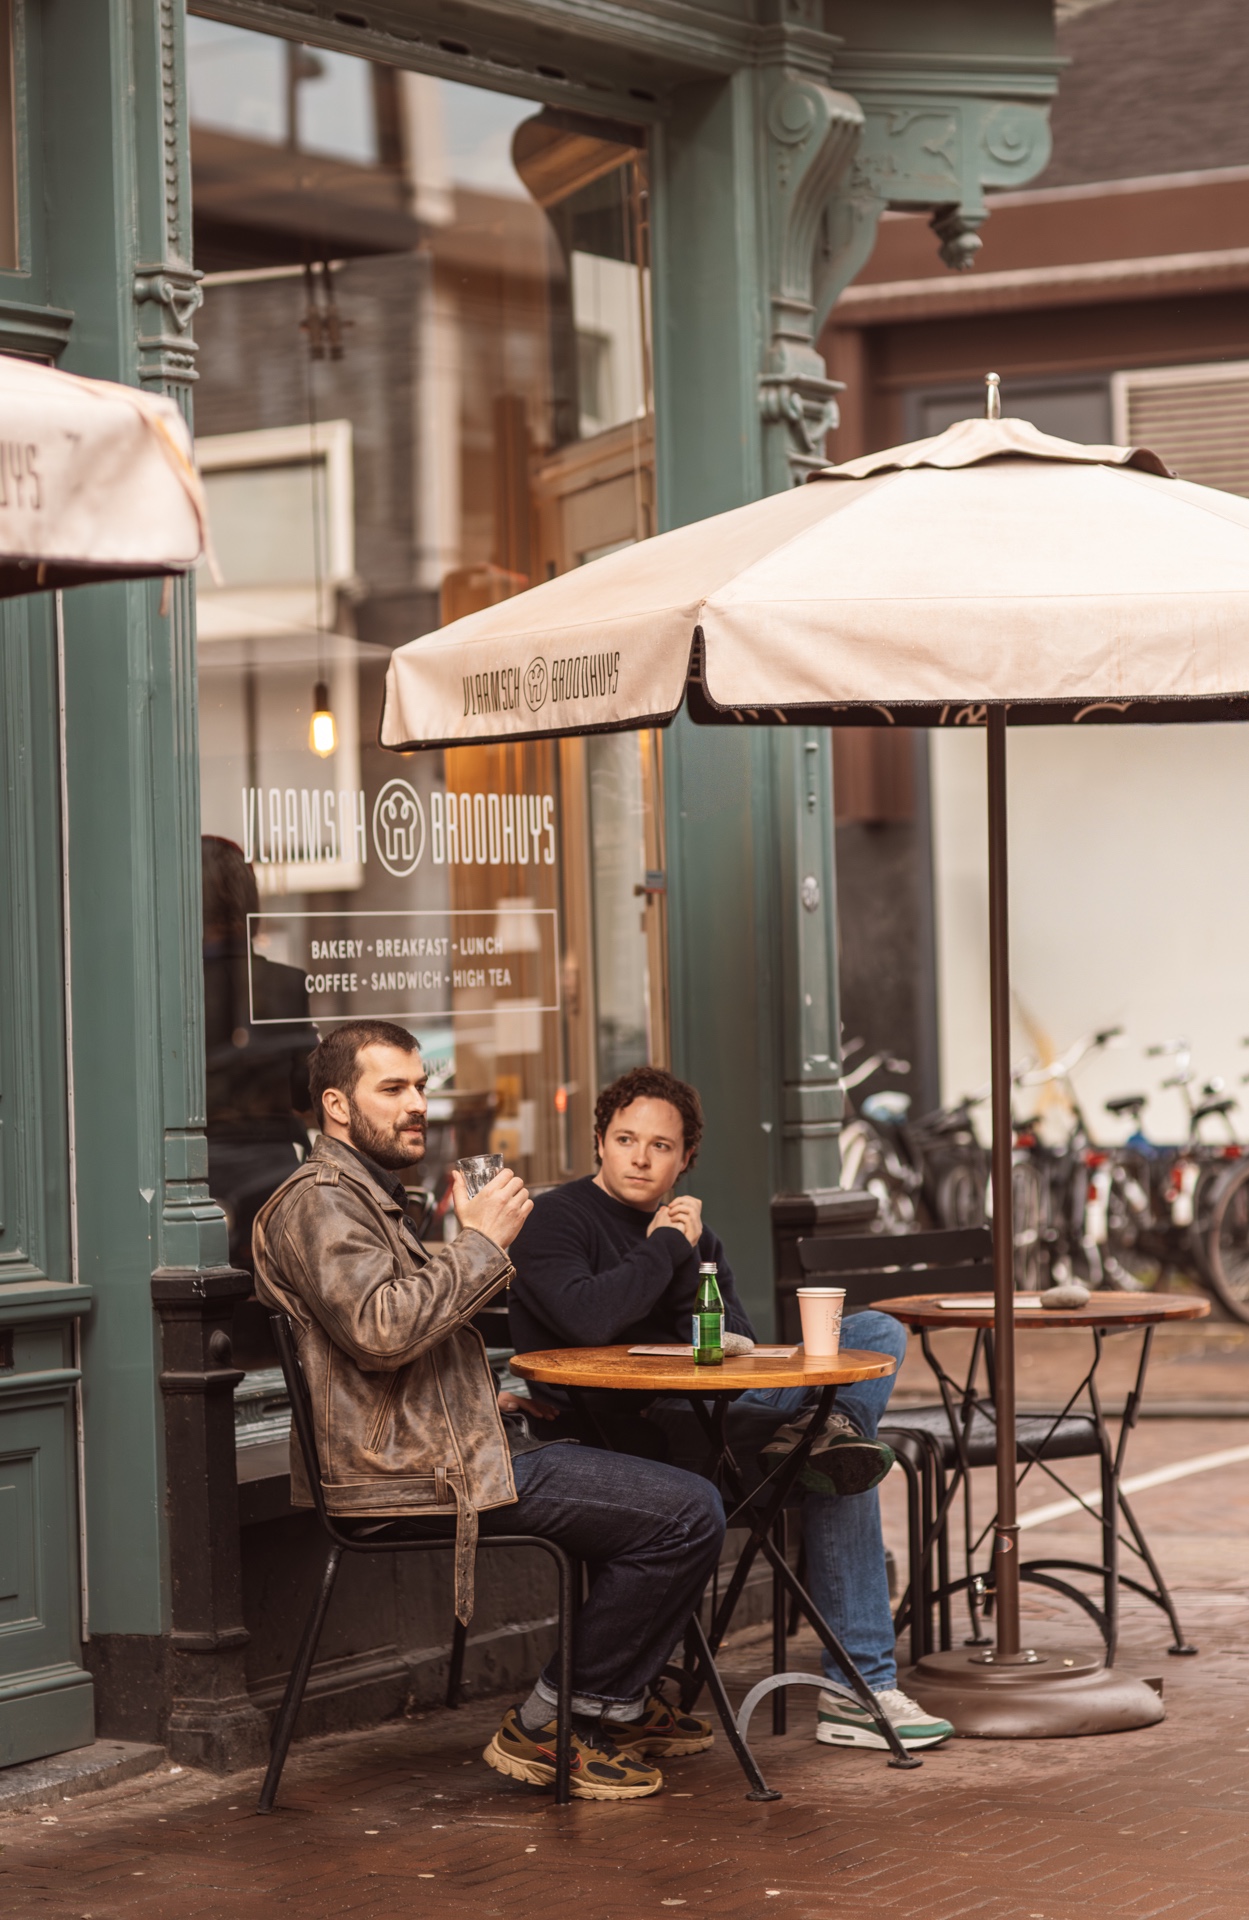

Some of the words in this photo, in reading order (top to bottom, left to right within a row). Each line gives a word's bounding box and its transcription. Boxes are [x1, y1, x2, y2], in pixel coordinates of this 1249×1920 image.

[462, 667, 520, 717] VLAAMSCH
[551, 651, 620, 703] BROODHUYS
[242, 787, 367, 864] VLAAMSCH
[430, 791, 556, 865] BROODHUYS
[311, 940, 363, 959] BAKERY
[376, 938, 449, 958] BREAKFAST
[460, 936, 504, 955] LUNCH
[305, 973, 359, 993] COFFEE
[371, 971, 442, 991] SANDWICH
[453, 969, 485, 988] HIGH
[489, 968, 512, 986] TEA
